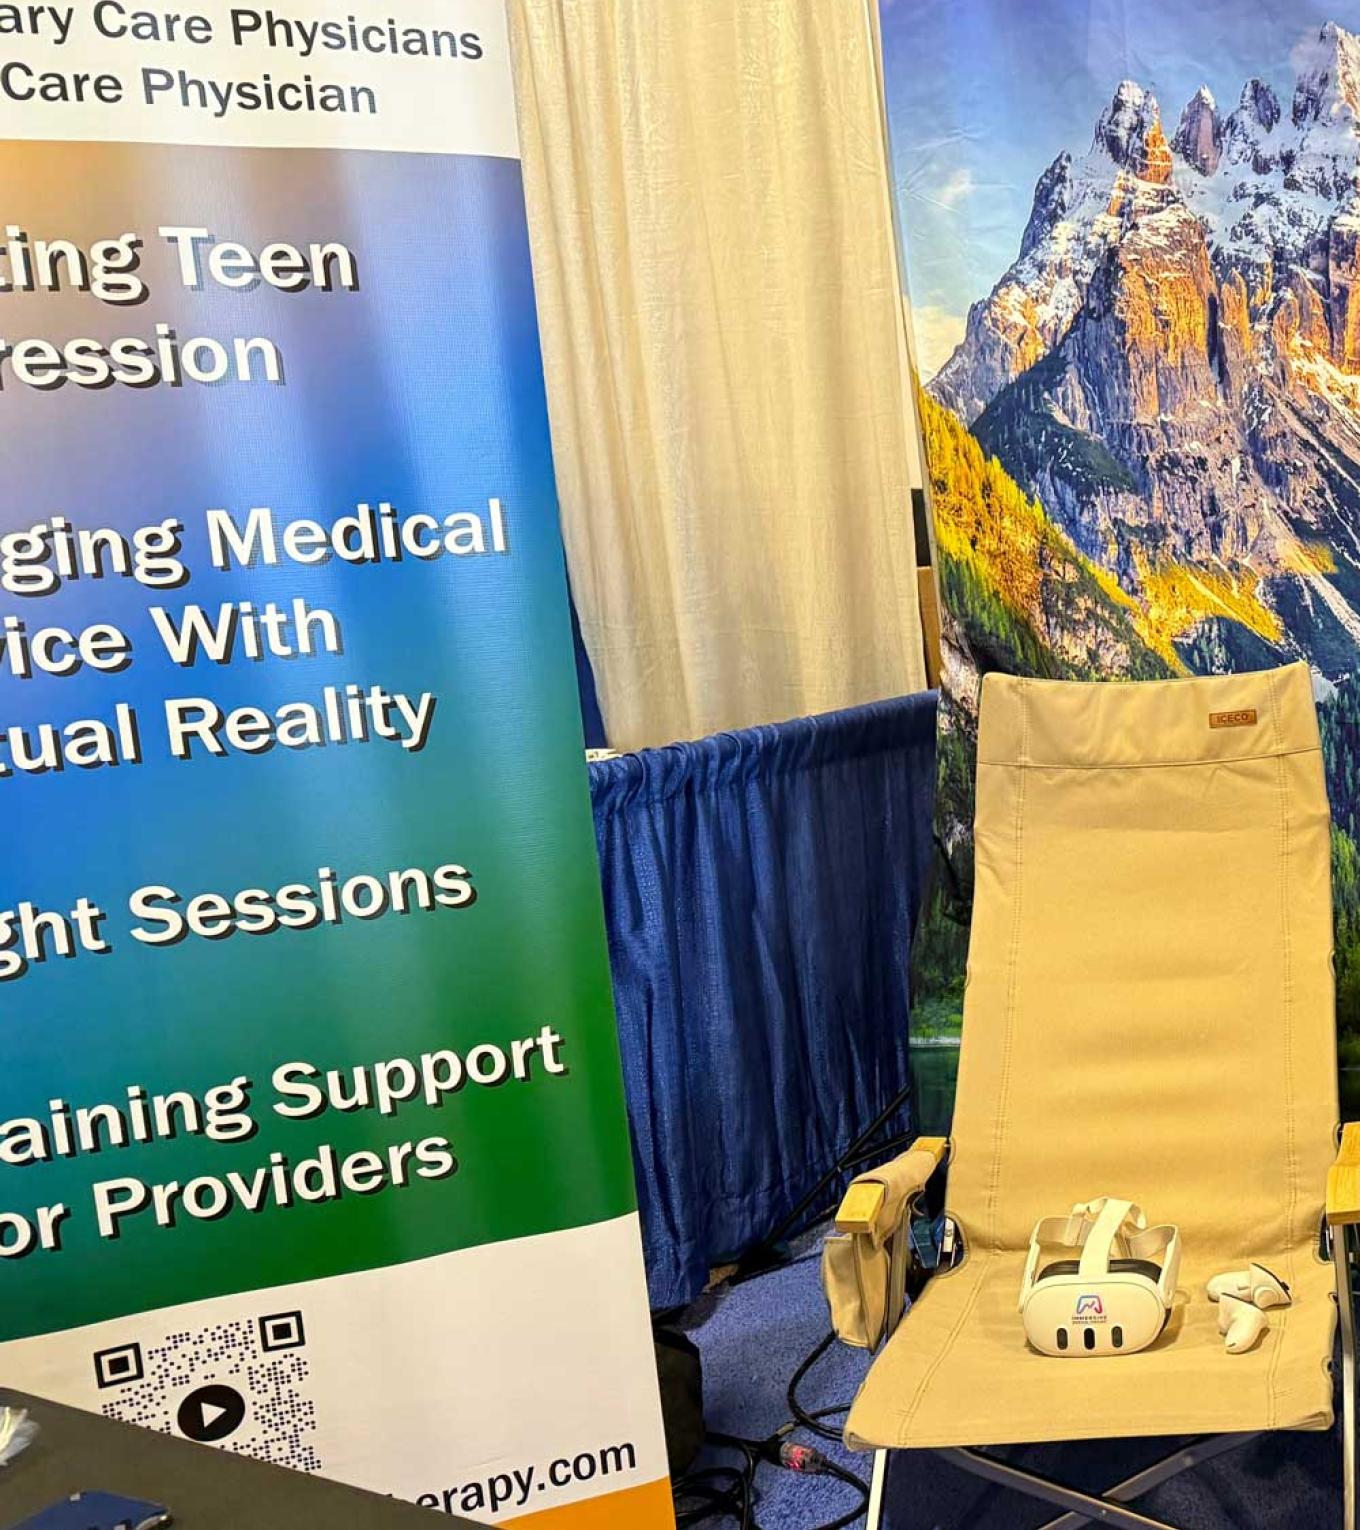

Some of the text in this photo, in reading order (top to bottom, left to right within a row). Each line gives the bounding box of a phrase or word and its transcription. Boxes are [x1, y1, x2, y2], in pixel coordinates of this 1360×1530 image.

[93, 0, 213, 45] Care
[230, 9, 485, 60] Physicians
[1, 61, 377, 117] Care Physician
[0, 225, 357, 303] ing Teen
[0, 323, 283, 386] ession
[0, 498, 507, 595] ging Medical
[0, 598, 341, 678] ice With
[0, 684, 434, 775] ual Reality
[1216, 712, 1249, 724] ICECO
[129, 864, 475, 944] Sessions
[0, 1025, 565, 1163] aining Support
[93, 1134, 456, 1238] Providers
[385, 1441, 636, 1513] erapy.com
